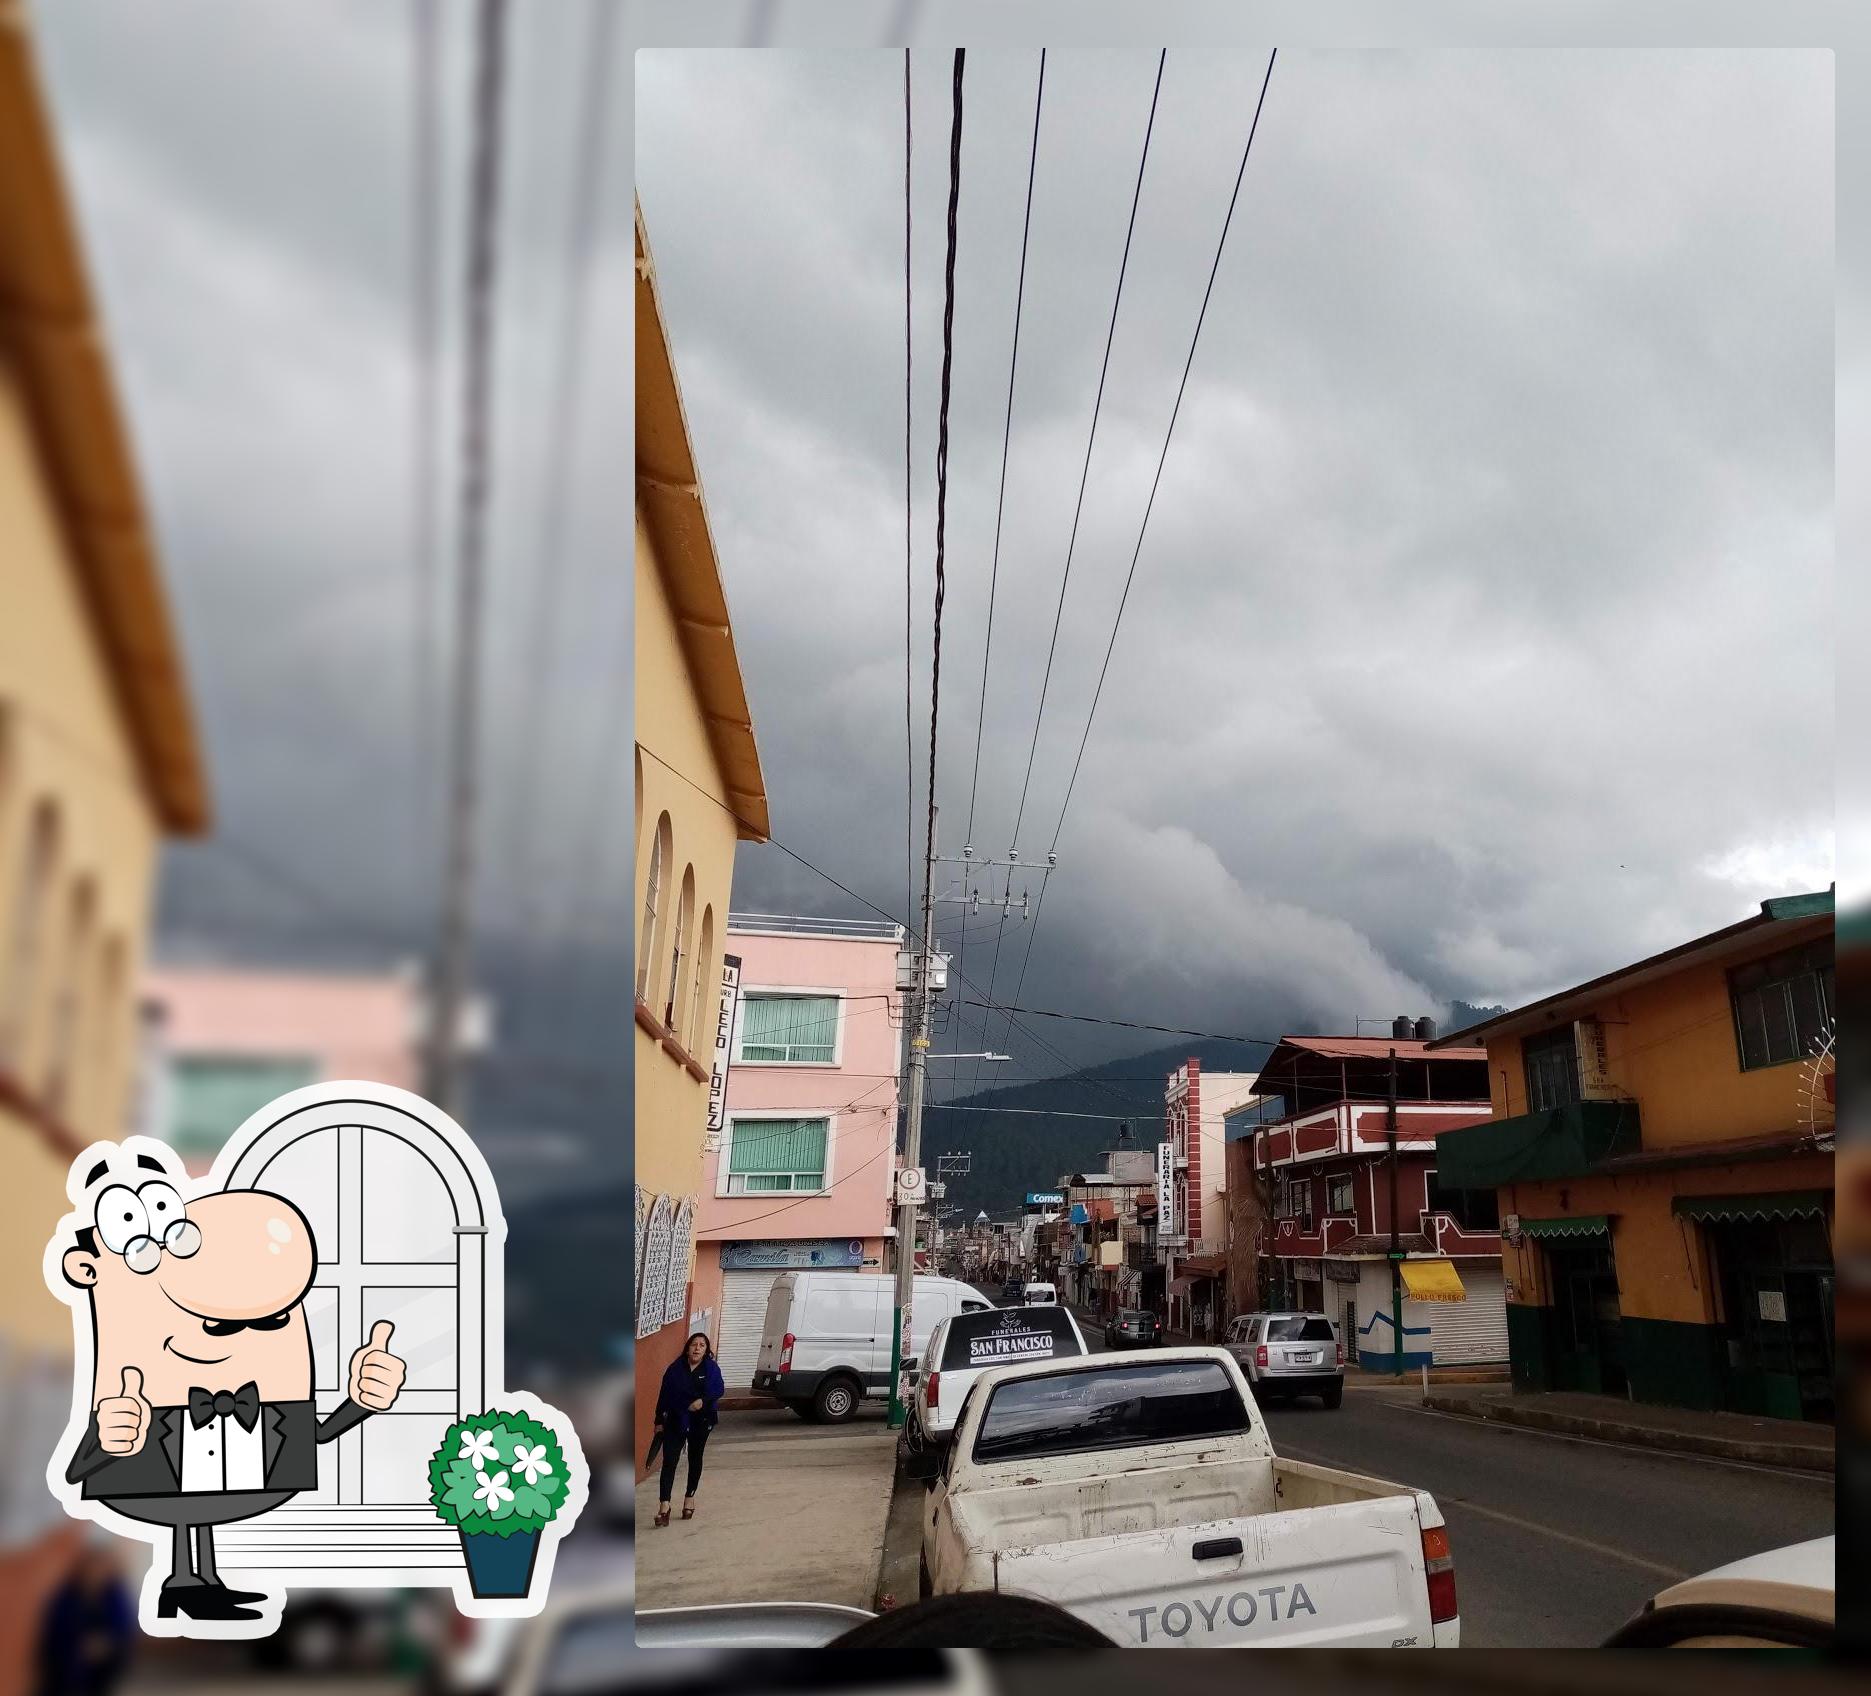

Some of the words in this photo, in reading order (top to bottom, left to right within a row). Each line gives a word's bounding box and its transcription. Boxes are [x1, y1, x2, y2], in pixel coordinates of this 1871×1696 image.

[707, 1062, 722, 1127] LOPEZ
[907, 1173, 912, 1184] E
[1033, 1193, 1063, 1203] Comex
[1163, 1191, 1170, 1201] LA
[991, 1326, 1031, 1335] FUNERALES
[970, 1341, 993, 1356] SAN
[996, 1335, 1053, 1353] FRANCISCO
[1128, 1583, 1317, 1643] TOYOTA
